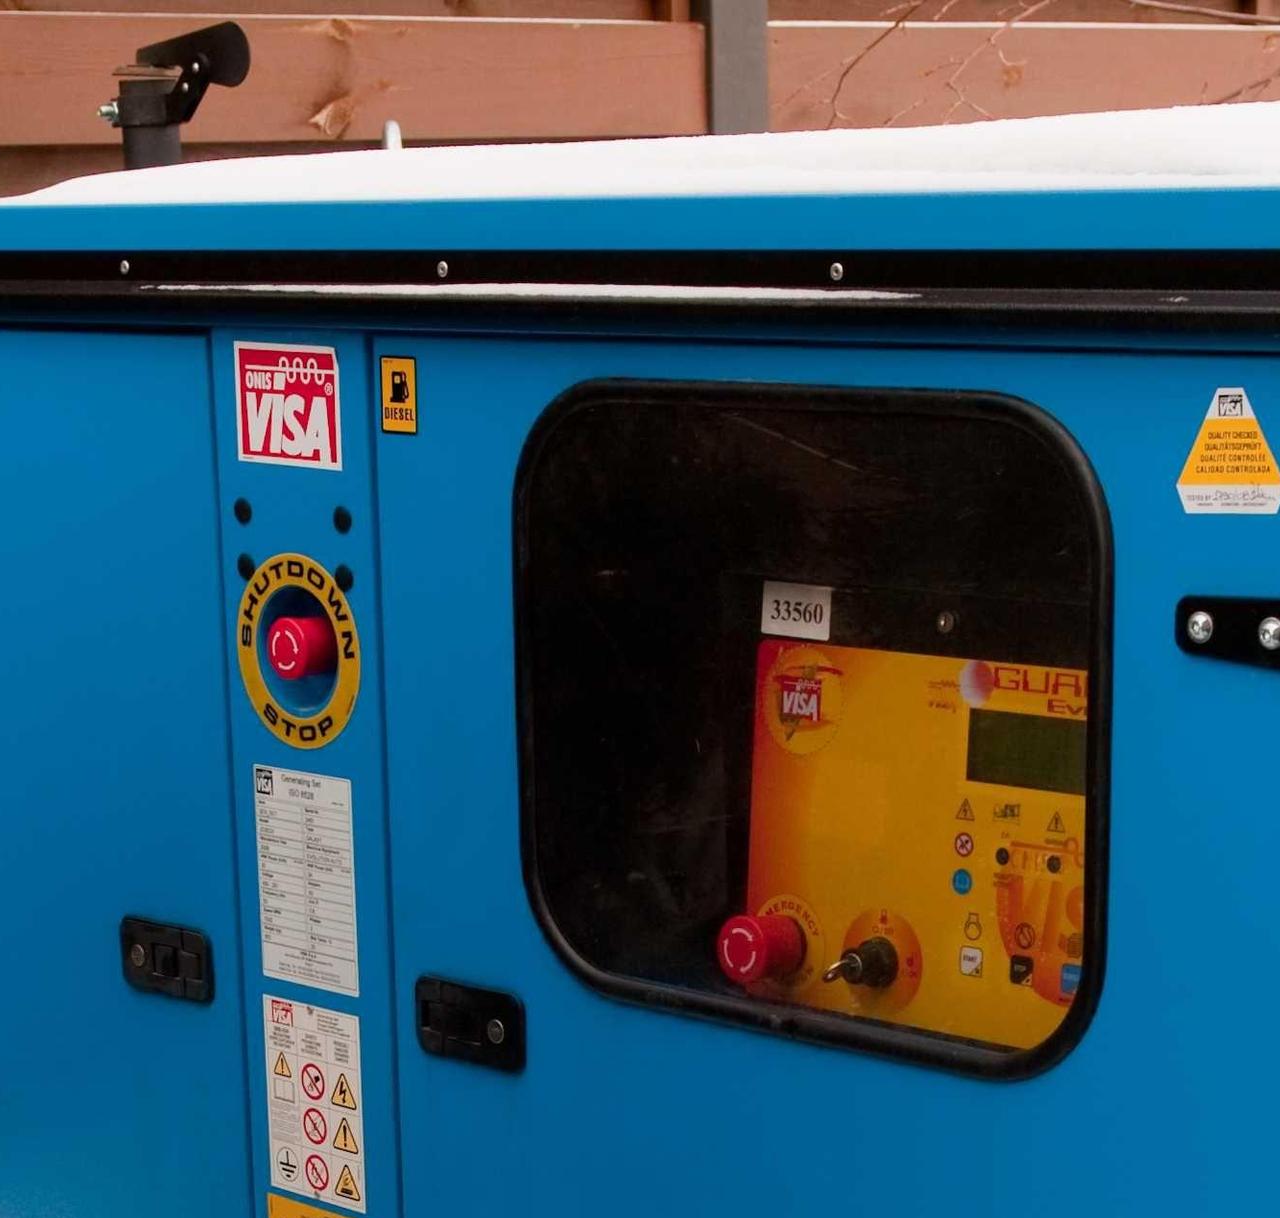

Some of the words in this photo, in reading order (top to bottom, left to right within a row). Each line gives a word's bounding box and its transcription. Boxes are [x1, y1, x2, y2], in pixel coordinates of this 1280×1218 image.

[245, 371, 272, 390] ONIS
[246, 391, 333, 462] VISA
[384, 406, 415, 422] DIESEL
[1208, 431, 1231, 440] QUALITY
[1232, 431, 1258, 440] CHECKED
[1196, 465, 1224, 473] CALIDAD
[1226, 465, 1270, 473] CONTROLADA
[241, 560, 356, 660] SHUTDOWN
[771, 599, 823, 624] 33560
[783, 690, 818, 721] VISA
[263, 702, 334, 742] STOP
